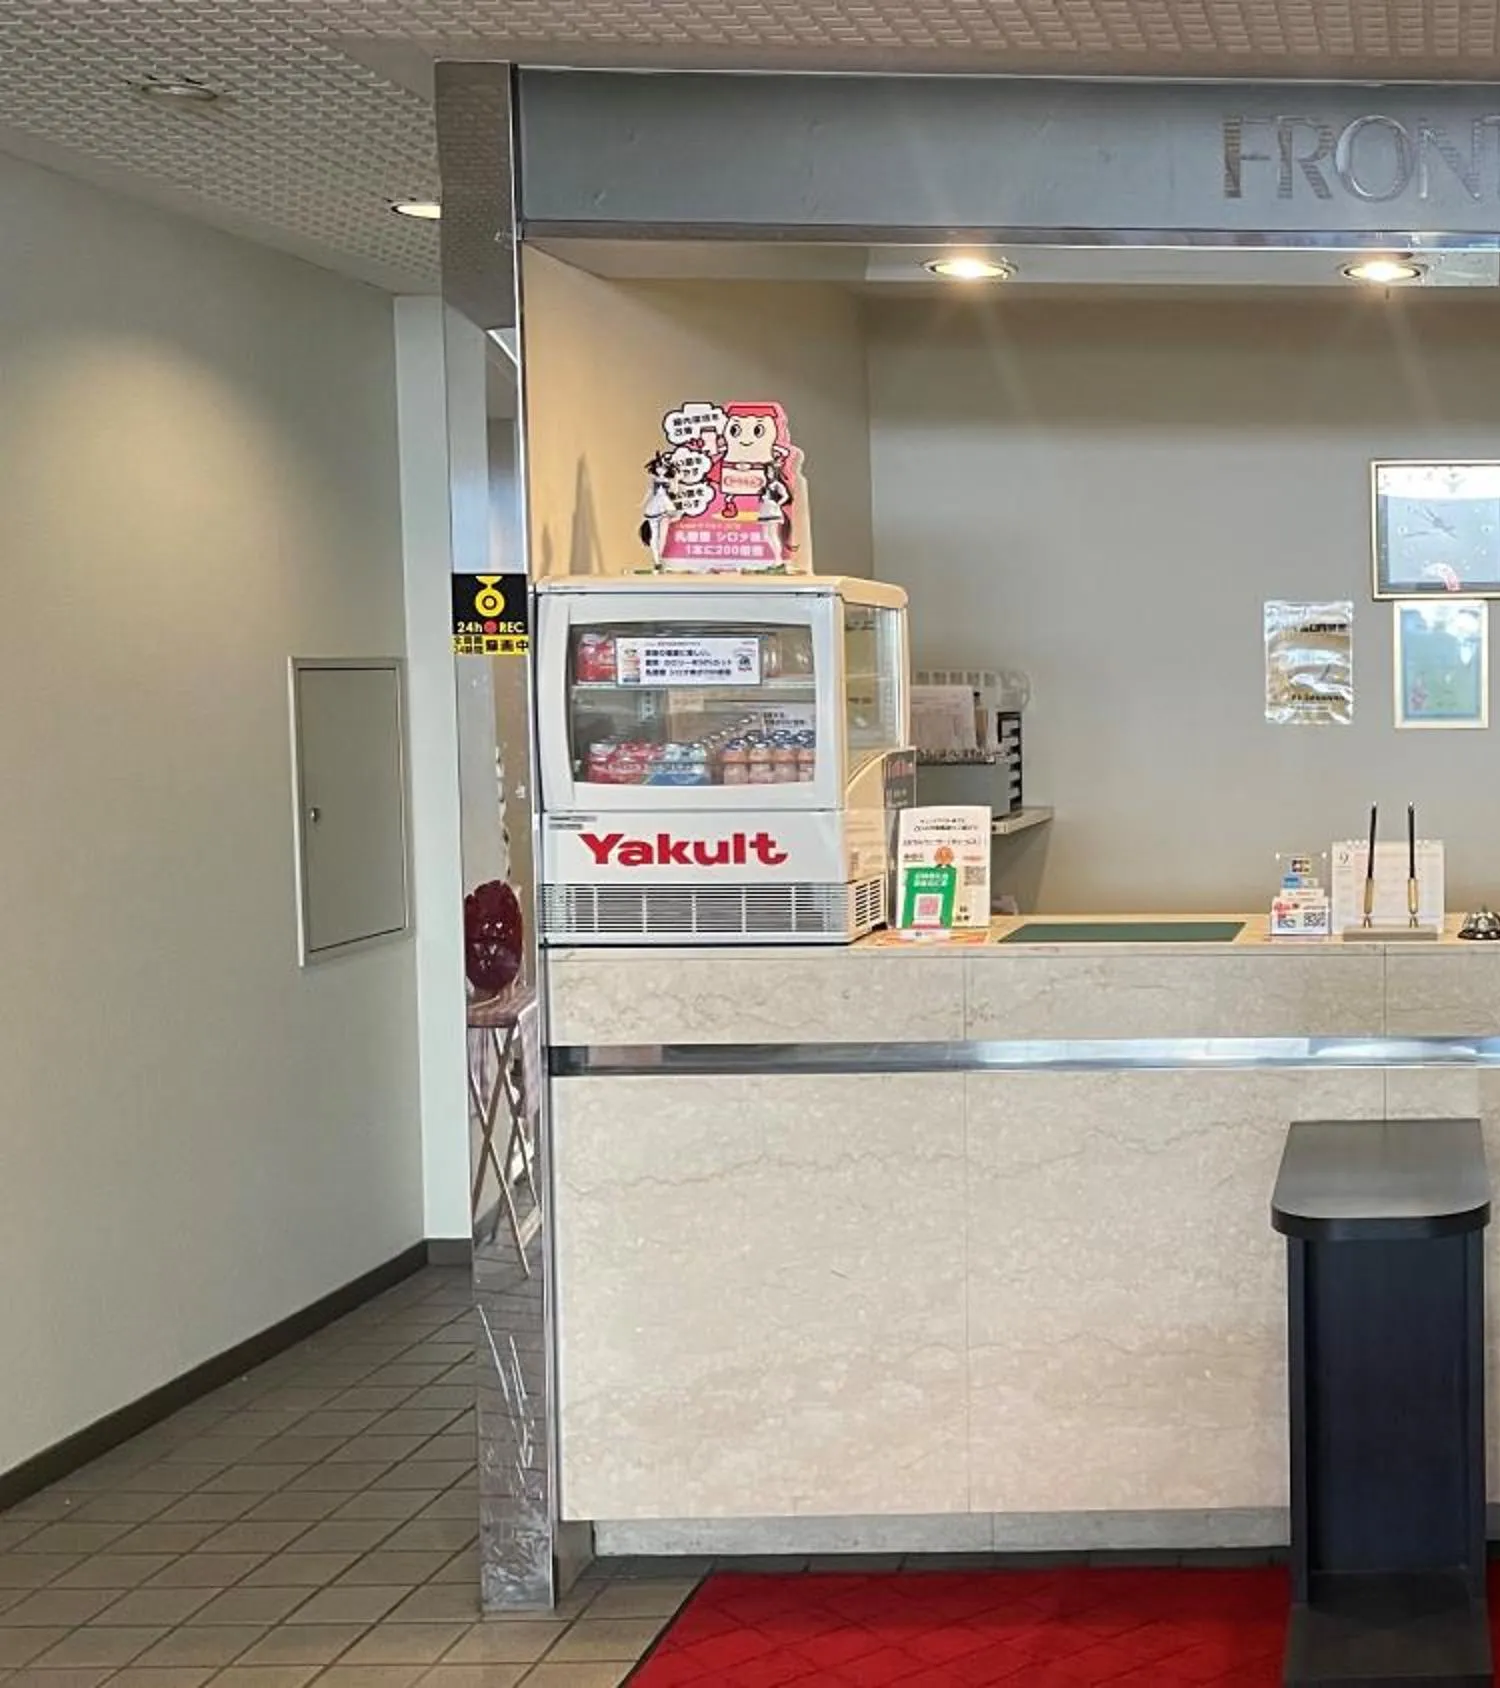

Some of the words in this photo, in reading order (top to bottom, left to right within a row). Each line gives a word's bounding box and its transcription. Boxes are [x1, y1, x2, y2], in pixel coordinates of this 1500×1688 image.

[457, 621, 483, 633] 24h
[499, 621, 525, 633] REC
[578, 832, 789, 867] Yakult
